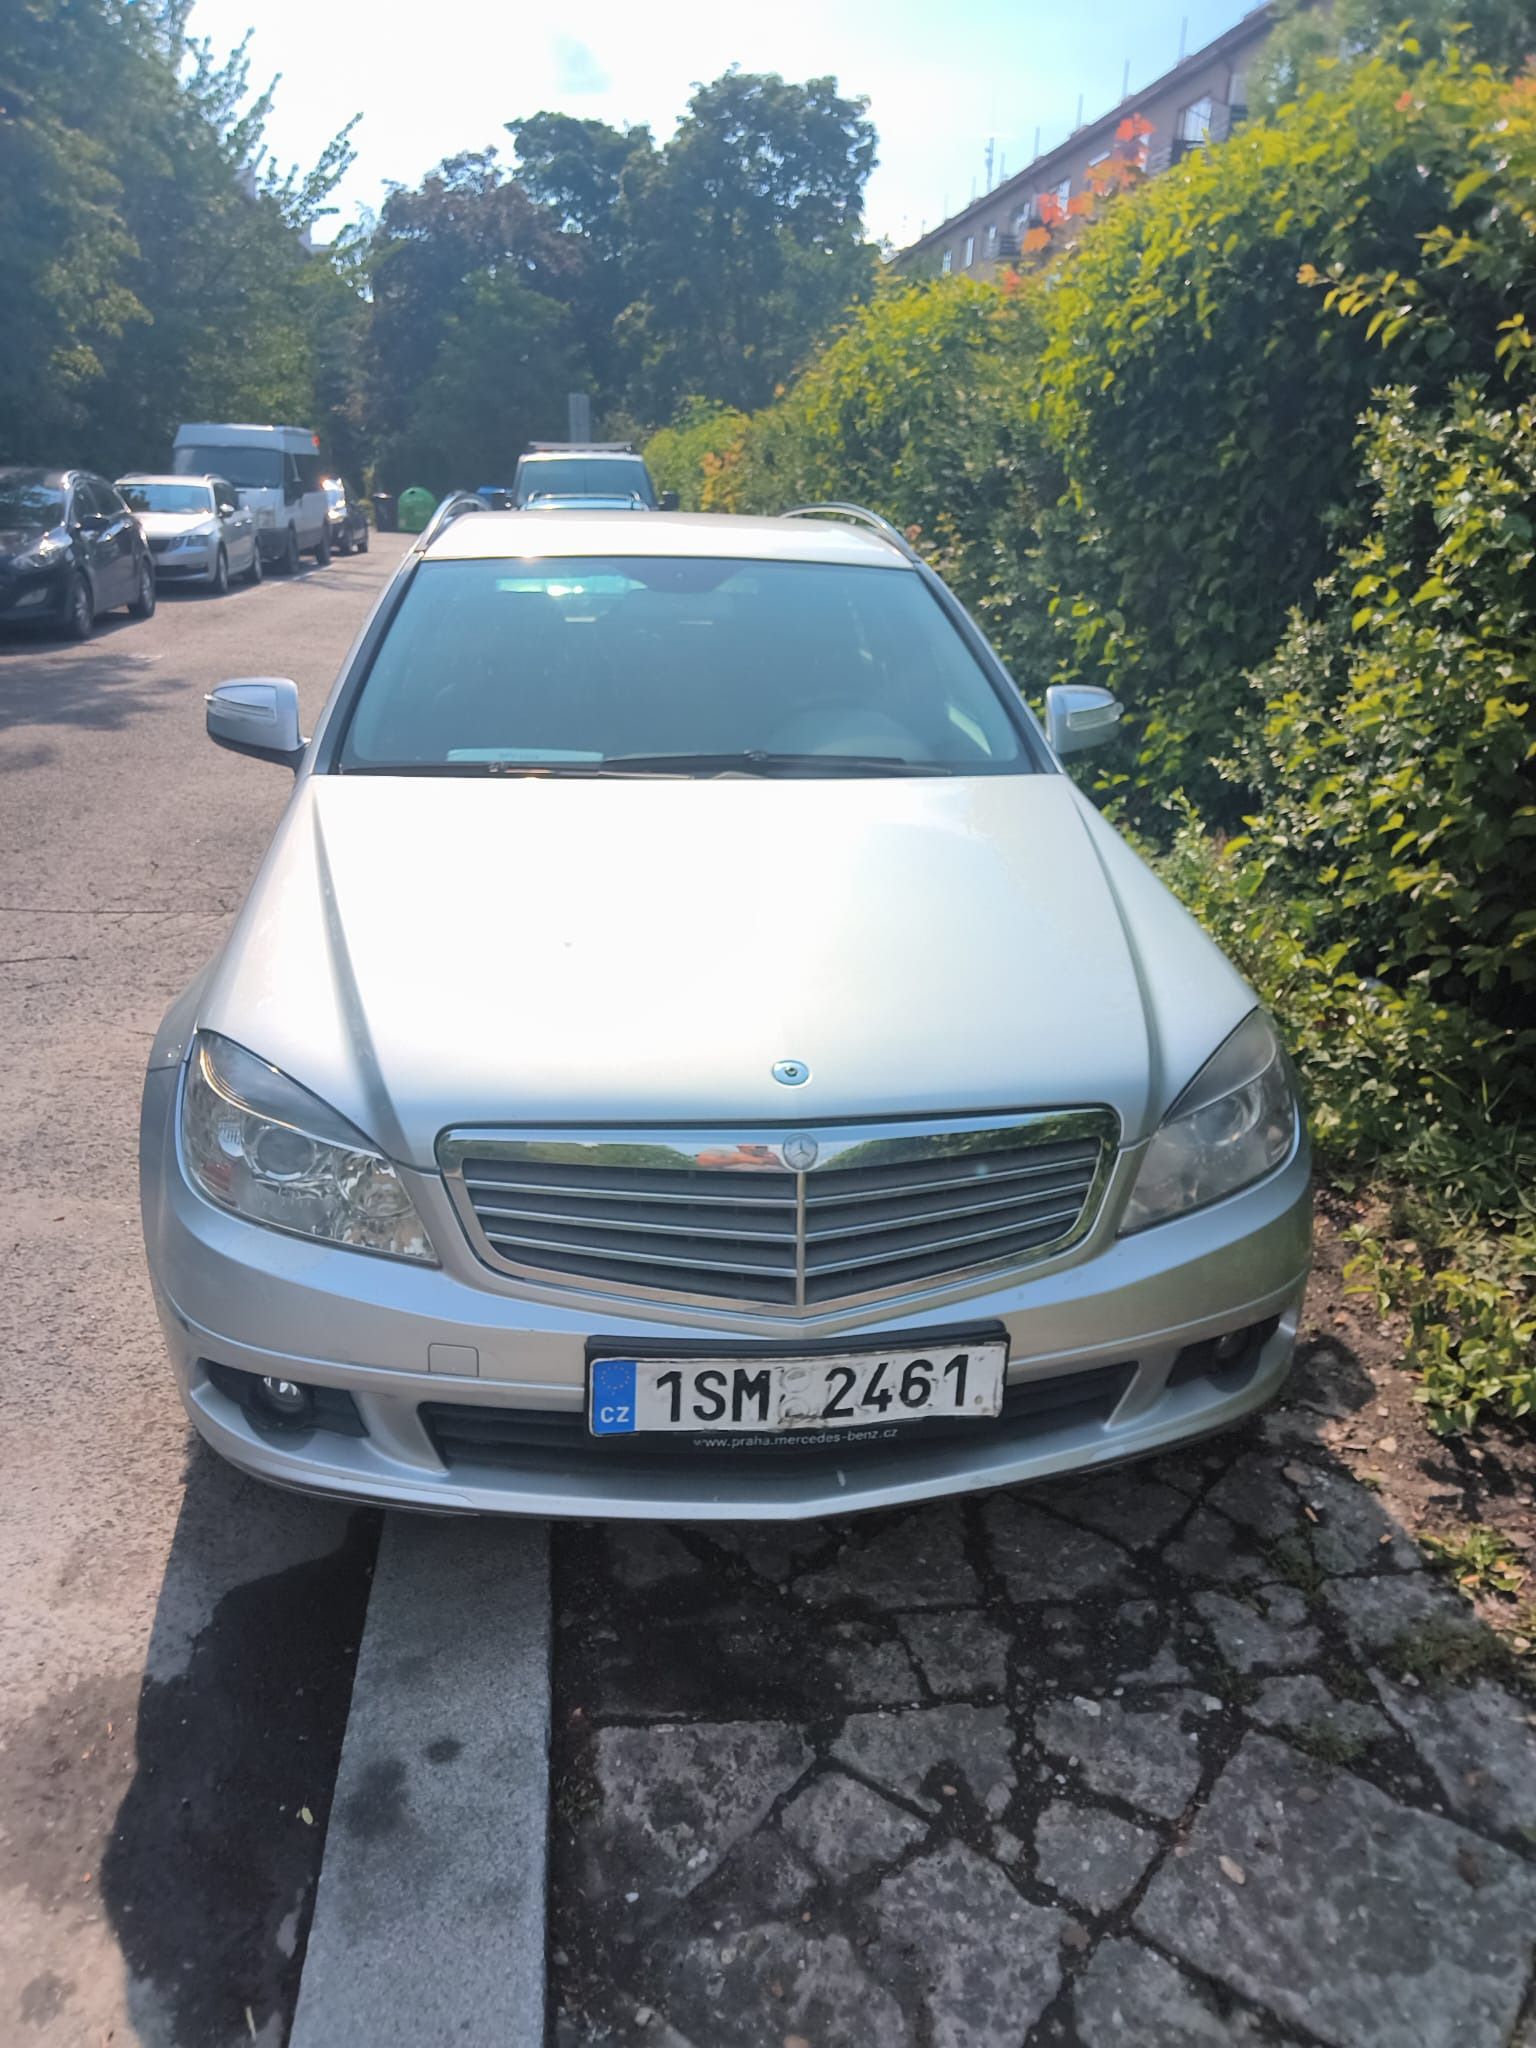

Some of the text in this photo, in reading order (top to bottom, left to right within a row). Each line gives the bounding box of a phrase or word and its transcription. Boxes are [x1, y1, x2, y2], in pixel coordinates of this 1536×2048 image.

[657, 1354, 968, 1422] 1SM 2461
[600, 1406, 630, 1423] CZ
[693, 1428, 898, 1448] www.praha.mercedes-benz.cz
